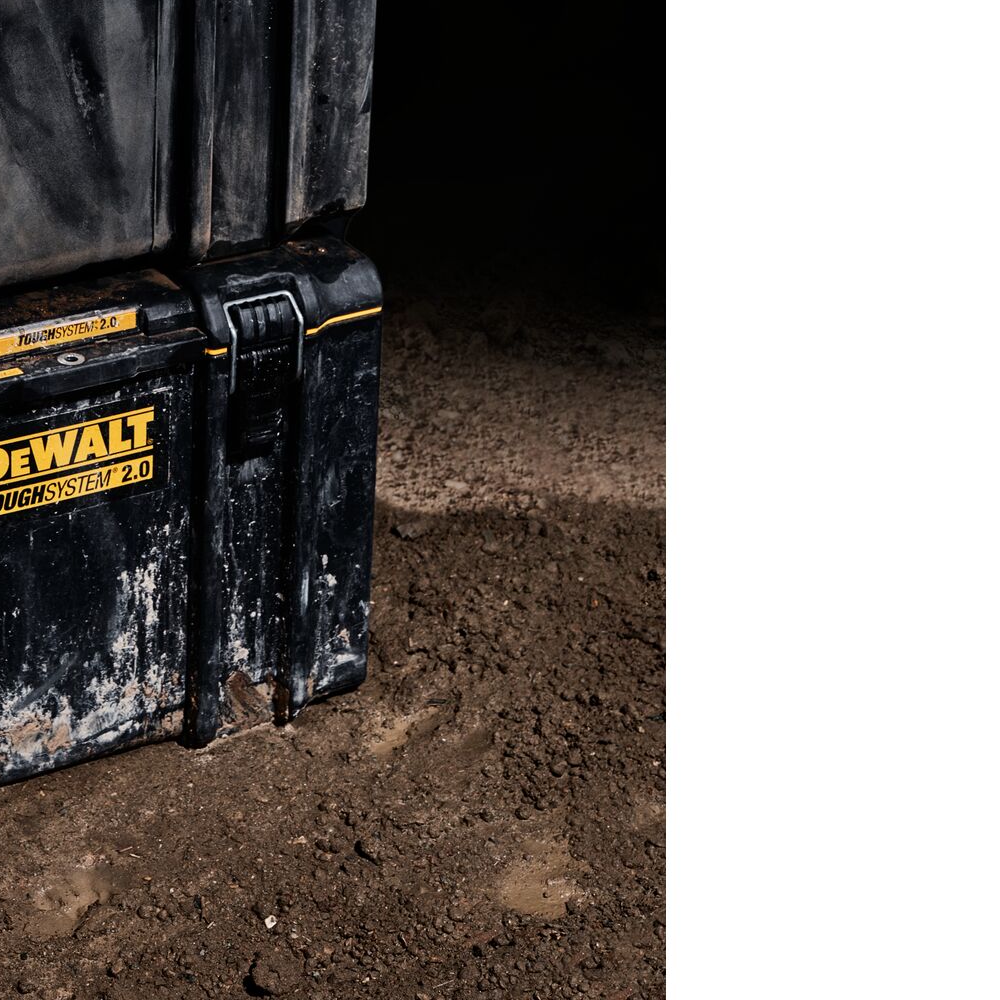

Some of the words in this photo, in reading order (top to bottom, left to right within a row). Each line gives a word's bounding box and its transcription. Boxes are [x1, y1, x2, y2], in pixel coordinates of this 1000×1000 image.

[17, 320, 95, 347] TOUGHSYSTEM
[99, 316, 117, 330] 2.0
[121, 460, 150, 483] 2.0
